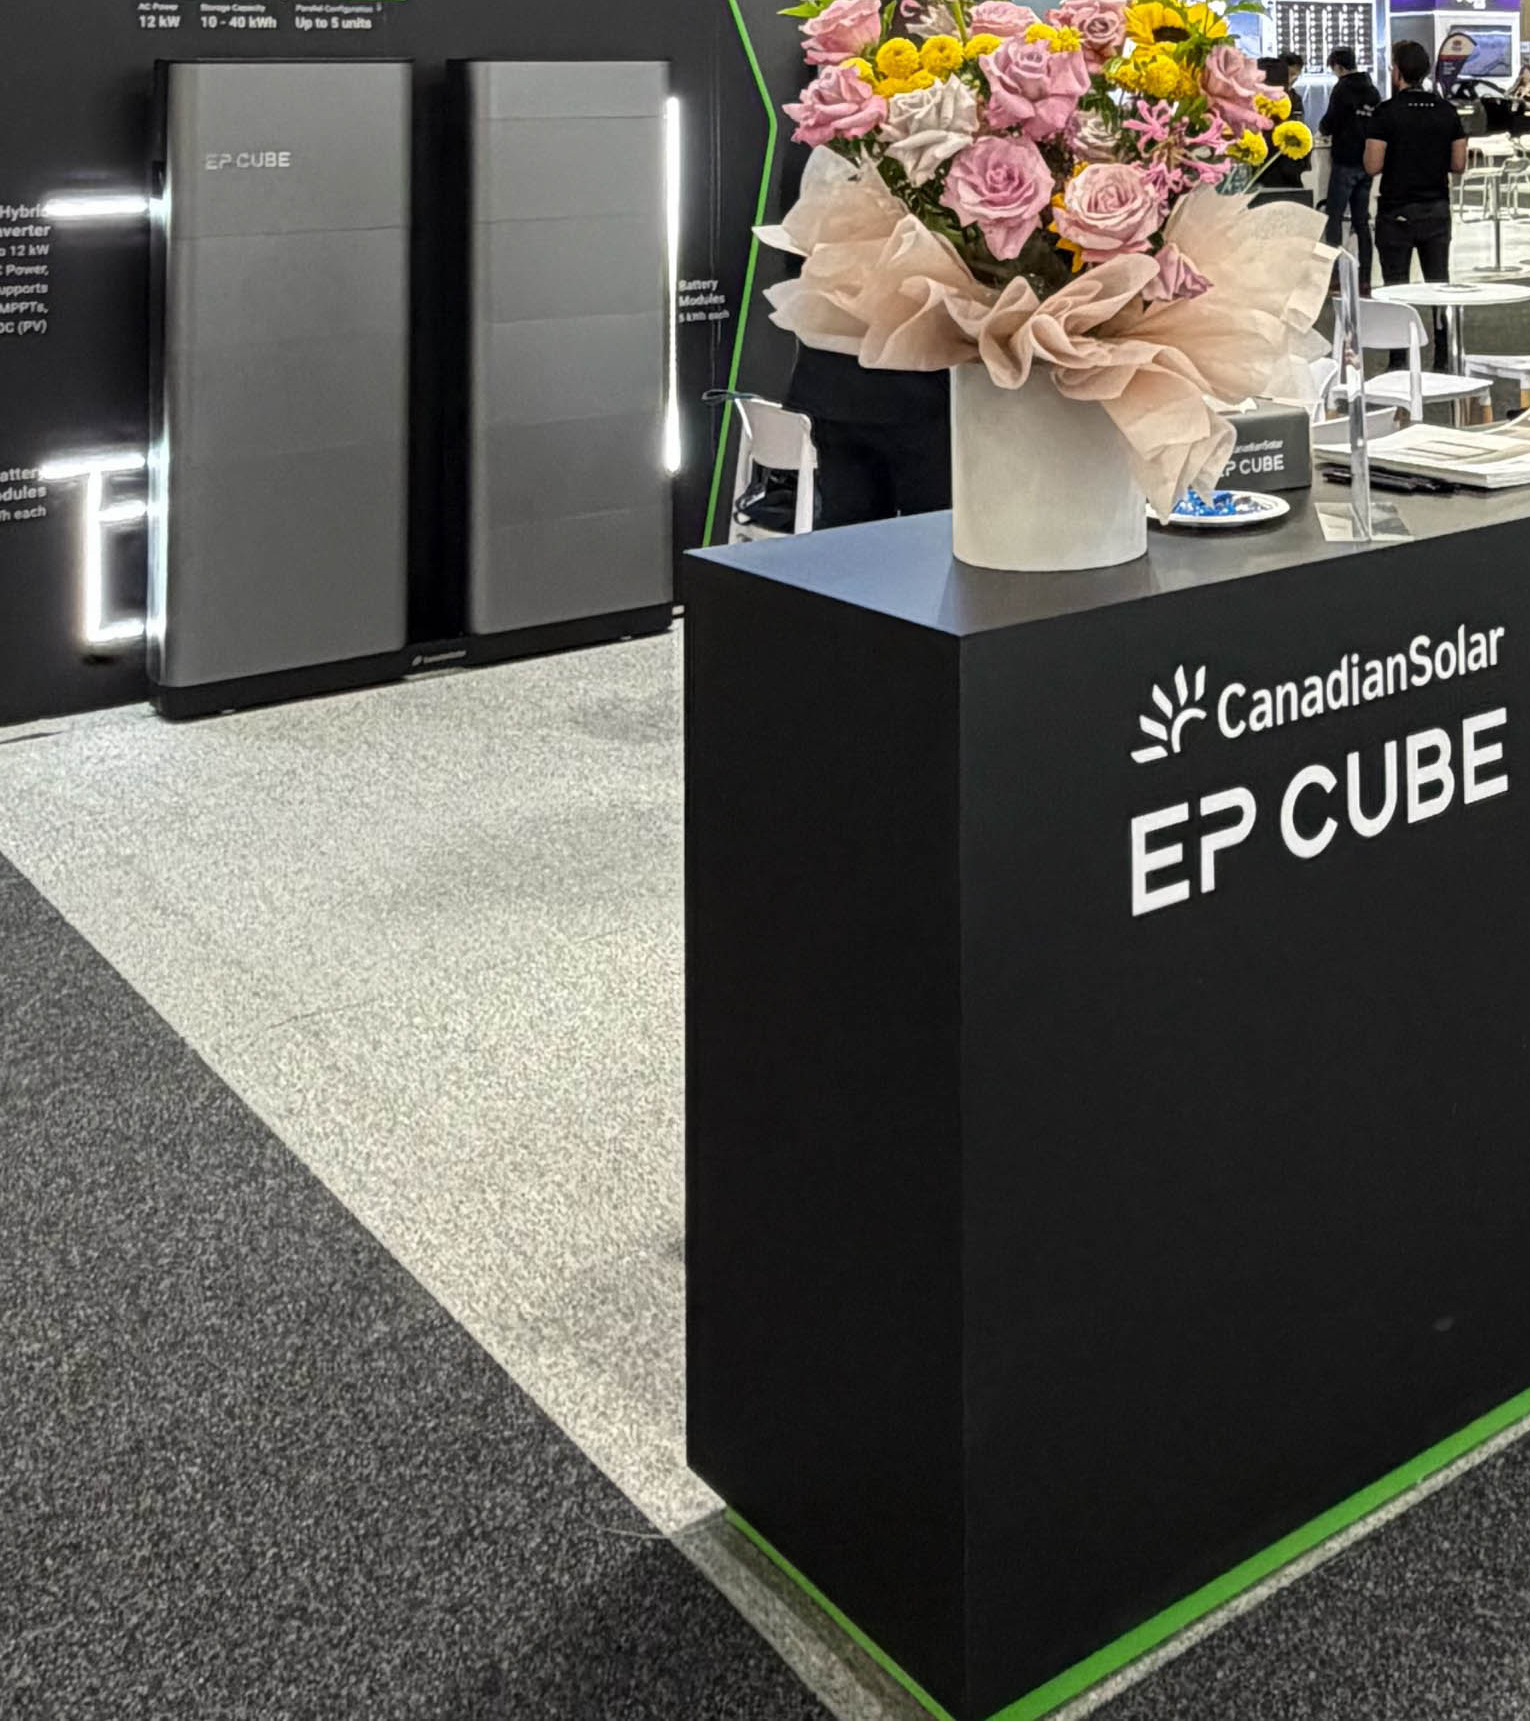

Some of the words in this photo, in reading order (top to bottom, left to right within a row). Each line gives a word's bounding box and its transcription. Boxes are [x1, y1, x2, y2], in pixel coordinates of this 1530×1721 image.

[204, 152, 233, 171] EP
[236, 150, 292, 170] CUBE
[1239, 454, 1285, 475] CUBE
[1217, 624, 1505, 739] CanadianSolar
[1130, 786, 1257, 917] EP
[1280, 707, 1509, 859] CUBE
